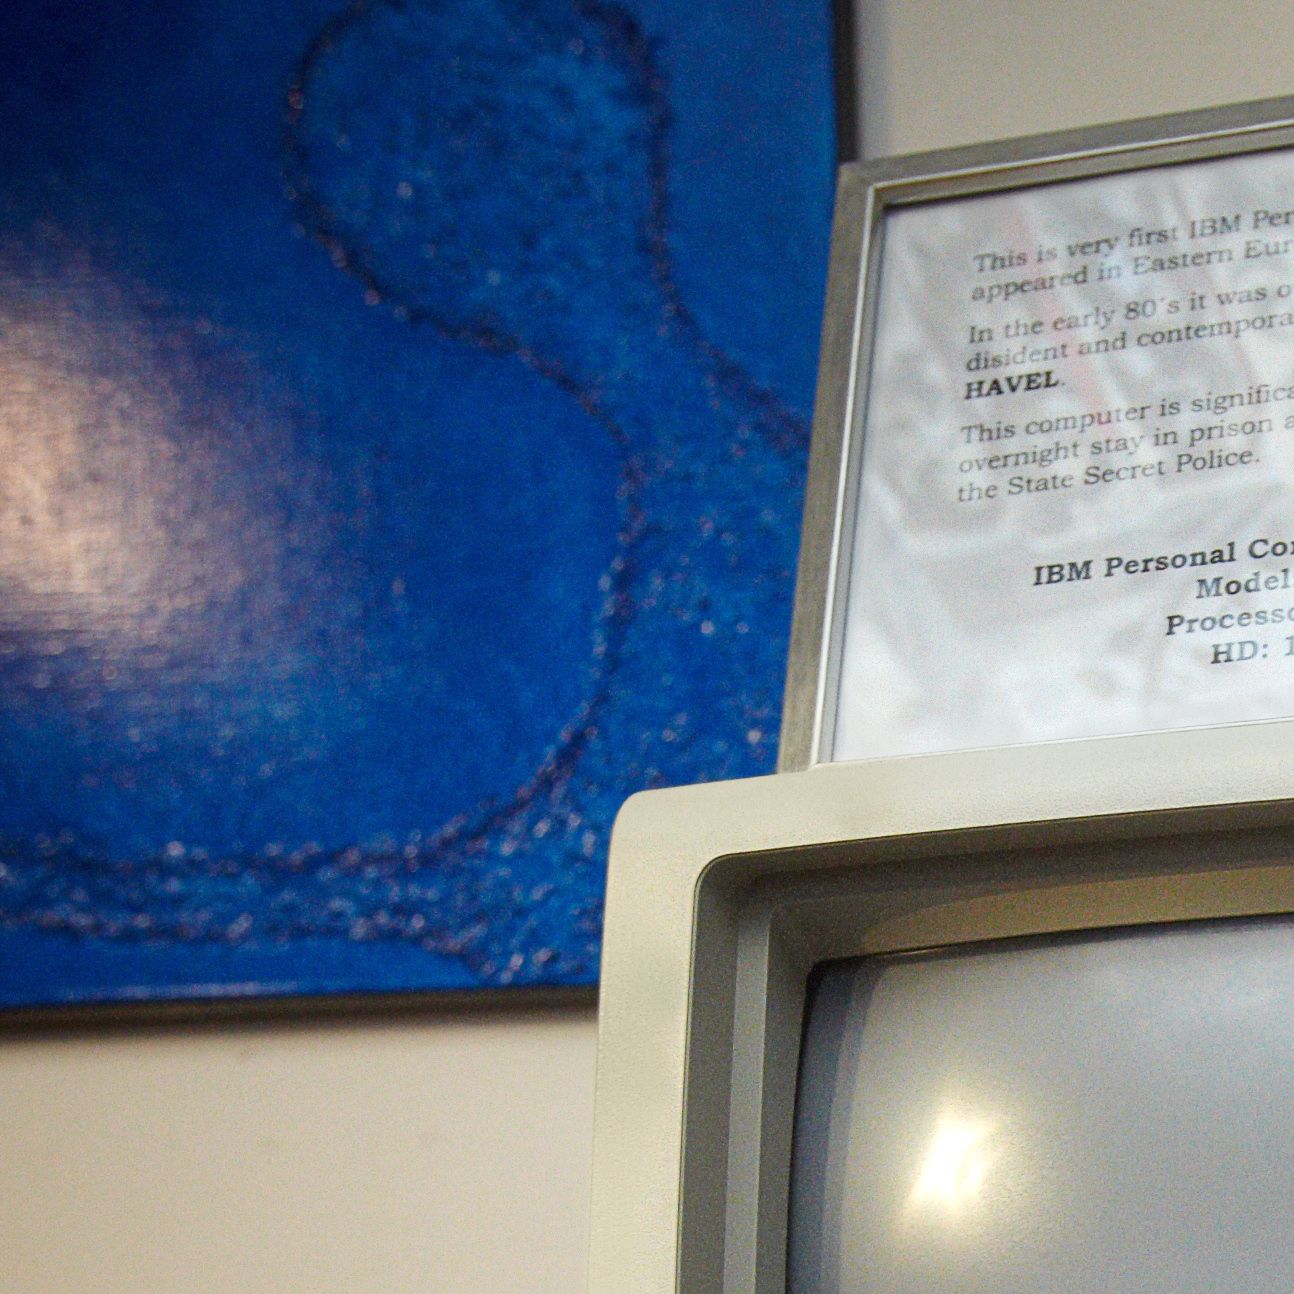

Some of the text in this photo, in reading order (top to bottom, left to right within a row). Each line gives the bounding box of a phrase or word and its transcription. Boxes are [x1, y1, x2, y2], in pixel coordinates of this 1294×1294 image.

[972, 251, 1027, 273] This
[1037, 243, 1058, 263] is
[1066, 236, 1120, 259] very
[1127, 225, 1178, 248] first
[1188, 213, 1242, 240] IBM
[970, 266, 1089, 304] appeared
[1097, 262, 1123, 283] in
[1132, 245, 1235, 276] Eastern
[968, 325, 994, 346] In
[1004, 316, 1044, 340] the
[1051, 305, 1117, 334] early
[1188, 291, 1207, 313] it
[1215, 285, 1268, 308] was
[965, 342, 1069, 374] disident
[1077, 331, 1128, 357] and
[964, 370, 1066, 401] HAVEL.
[958, 440, 1081, 476] overnight
[1090, 432, 1145, 457] stay
[1153, 426, 1179, 448] in
[1188, 412, 1274, 448] prison
[960, 424, 1016, 445] This
[1025, 404, 1152, 436] computer
[1159, 397, 1182, 418] is
[958, 446, 1262, 502] the State Secret Police.
[1033, 559, 1094, 587] IBM
[1103, 541, 1238, 578] Personal
[1210, 639, 1269, 665] HD:
